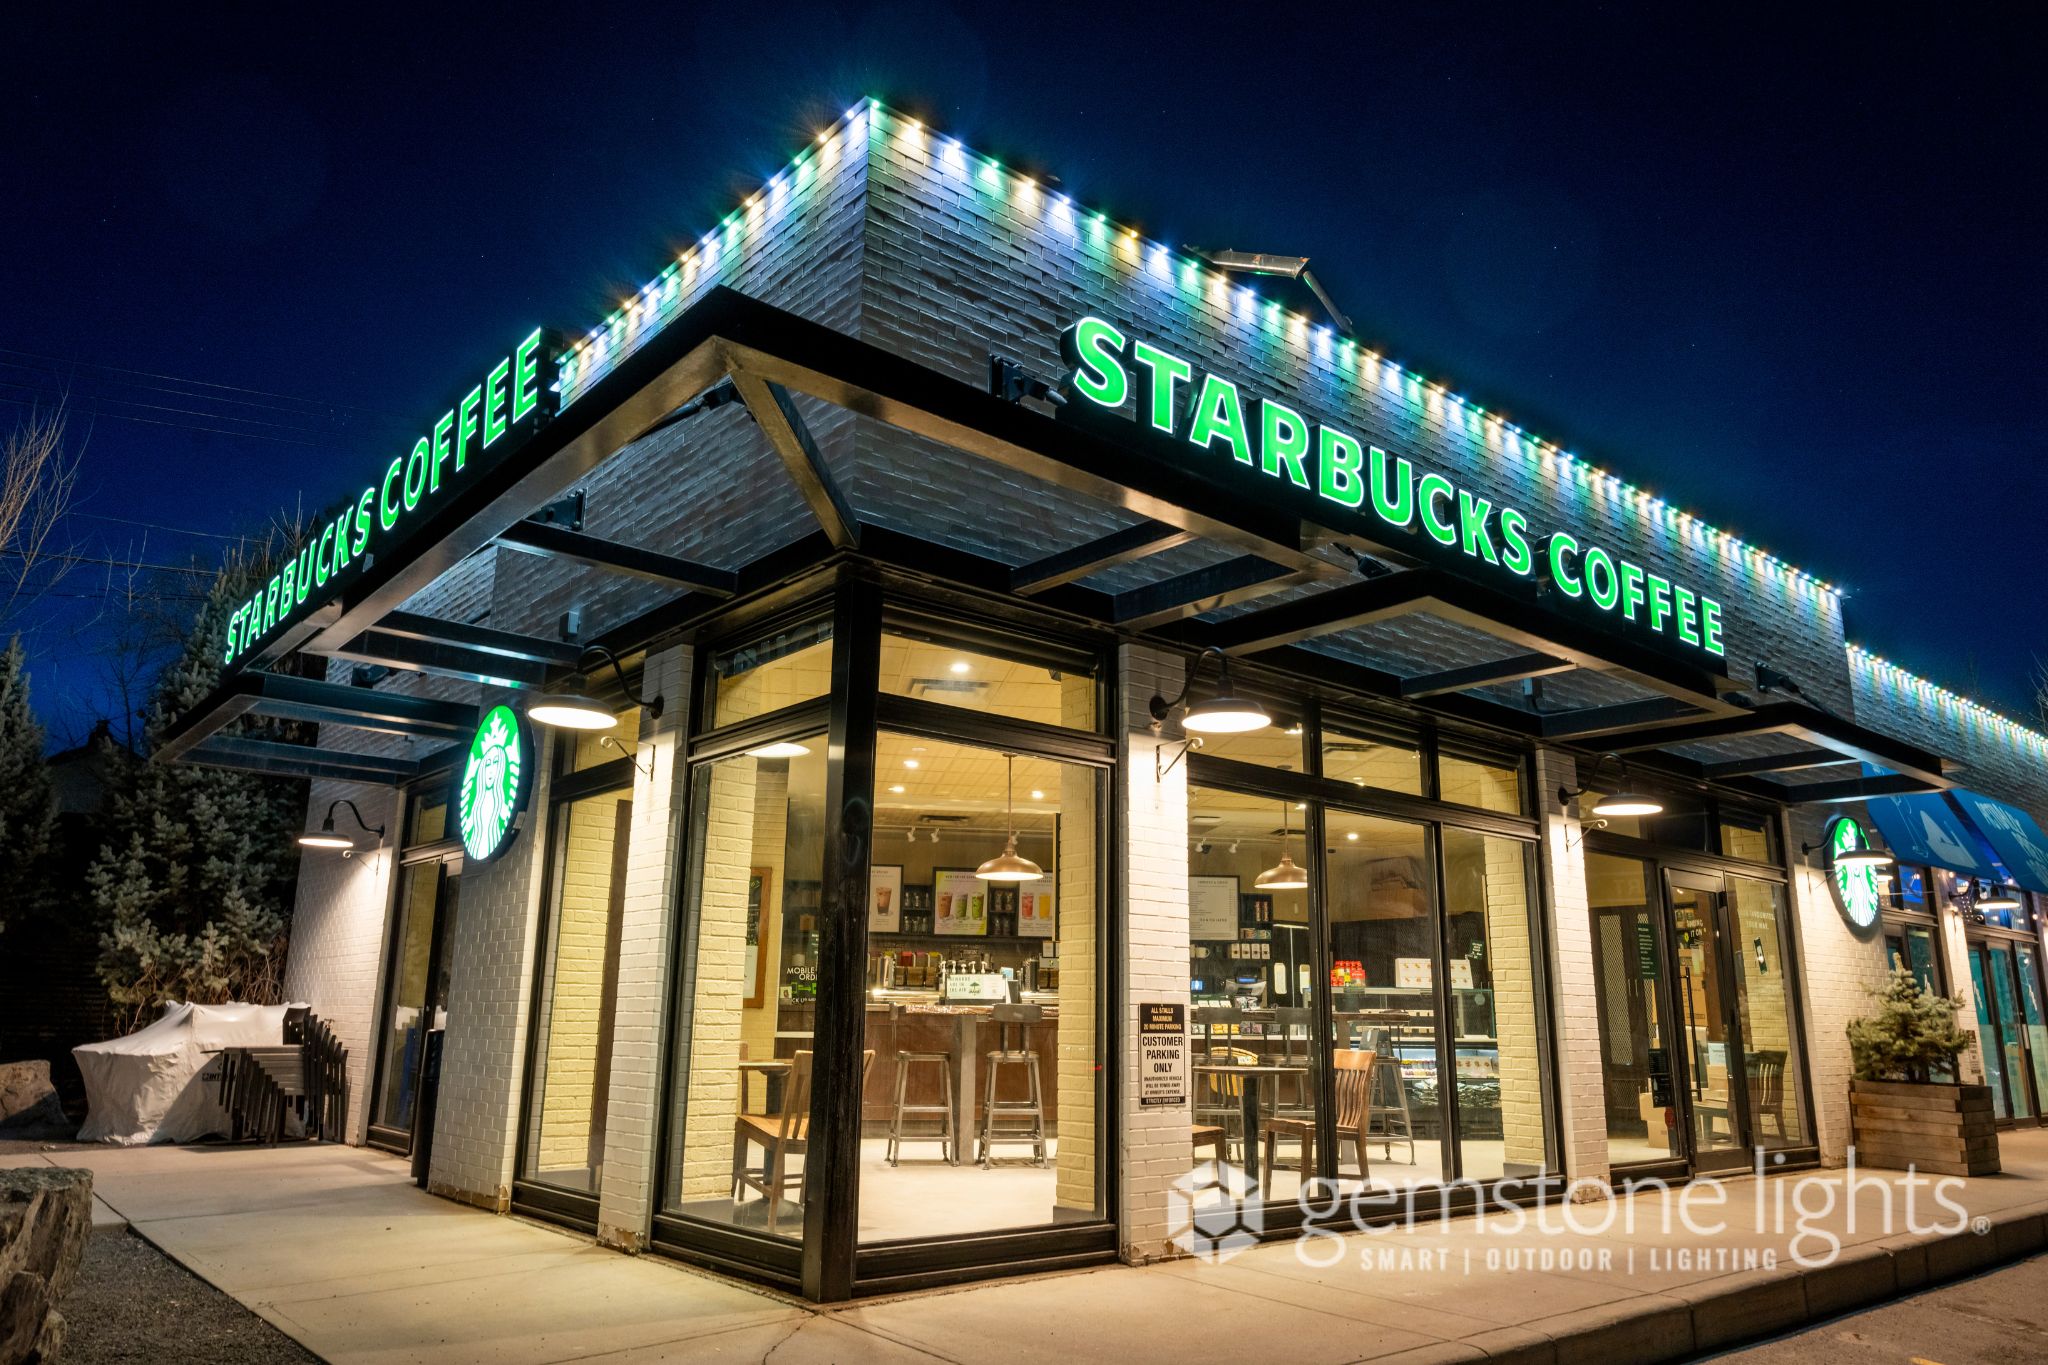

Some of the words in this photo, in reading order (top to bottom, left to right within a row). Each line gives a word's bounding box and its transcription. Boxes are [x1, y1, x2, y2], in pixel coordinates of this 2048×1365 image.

[1073, 316, 1532, 576] STARBUCKS
[1550, 532, 1725, 658] COFFEE
[225, 487, 375, 665] STARBUCKS
[380, 326, 542, 532] COFFEE
[786, 966, 815, 975] MOBILE
[798, 973, 818, 981] ORD
[1142, 1036, 1184, 1047] CUSTOMER
[1146, 1049, 1180, 1060] PARKING
[1153, 1062, 1173, 1073] ONLY
